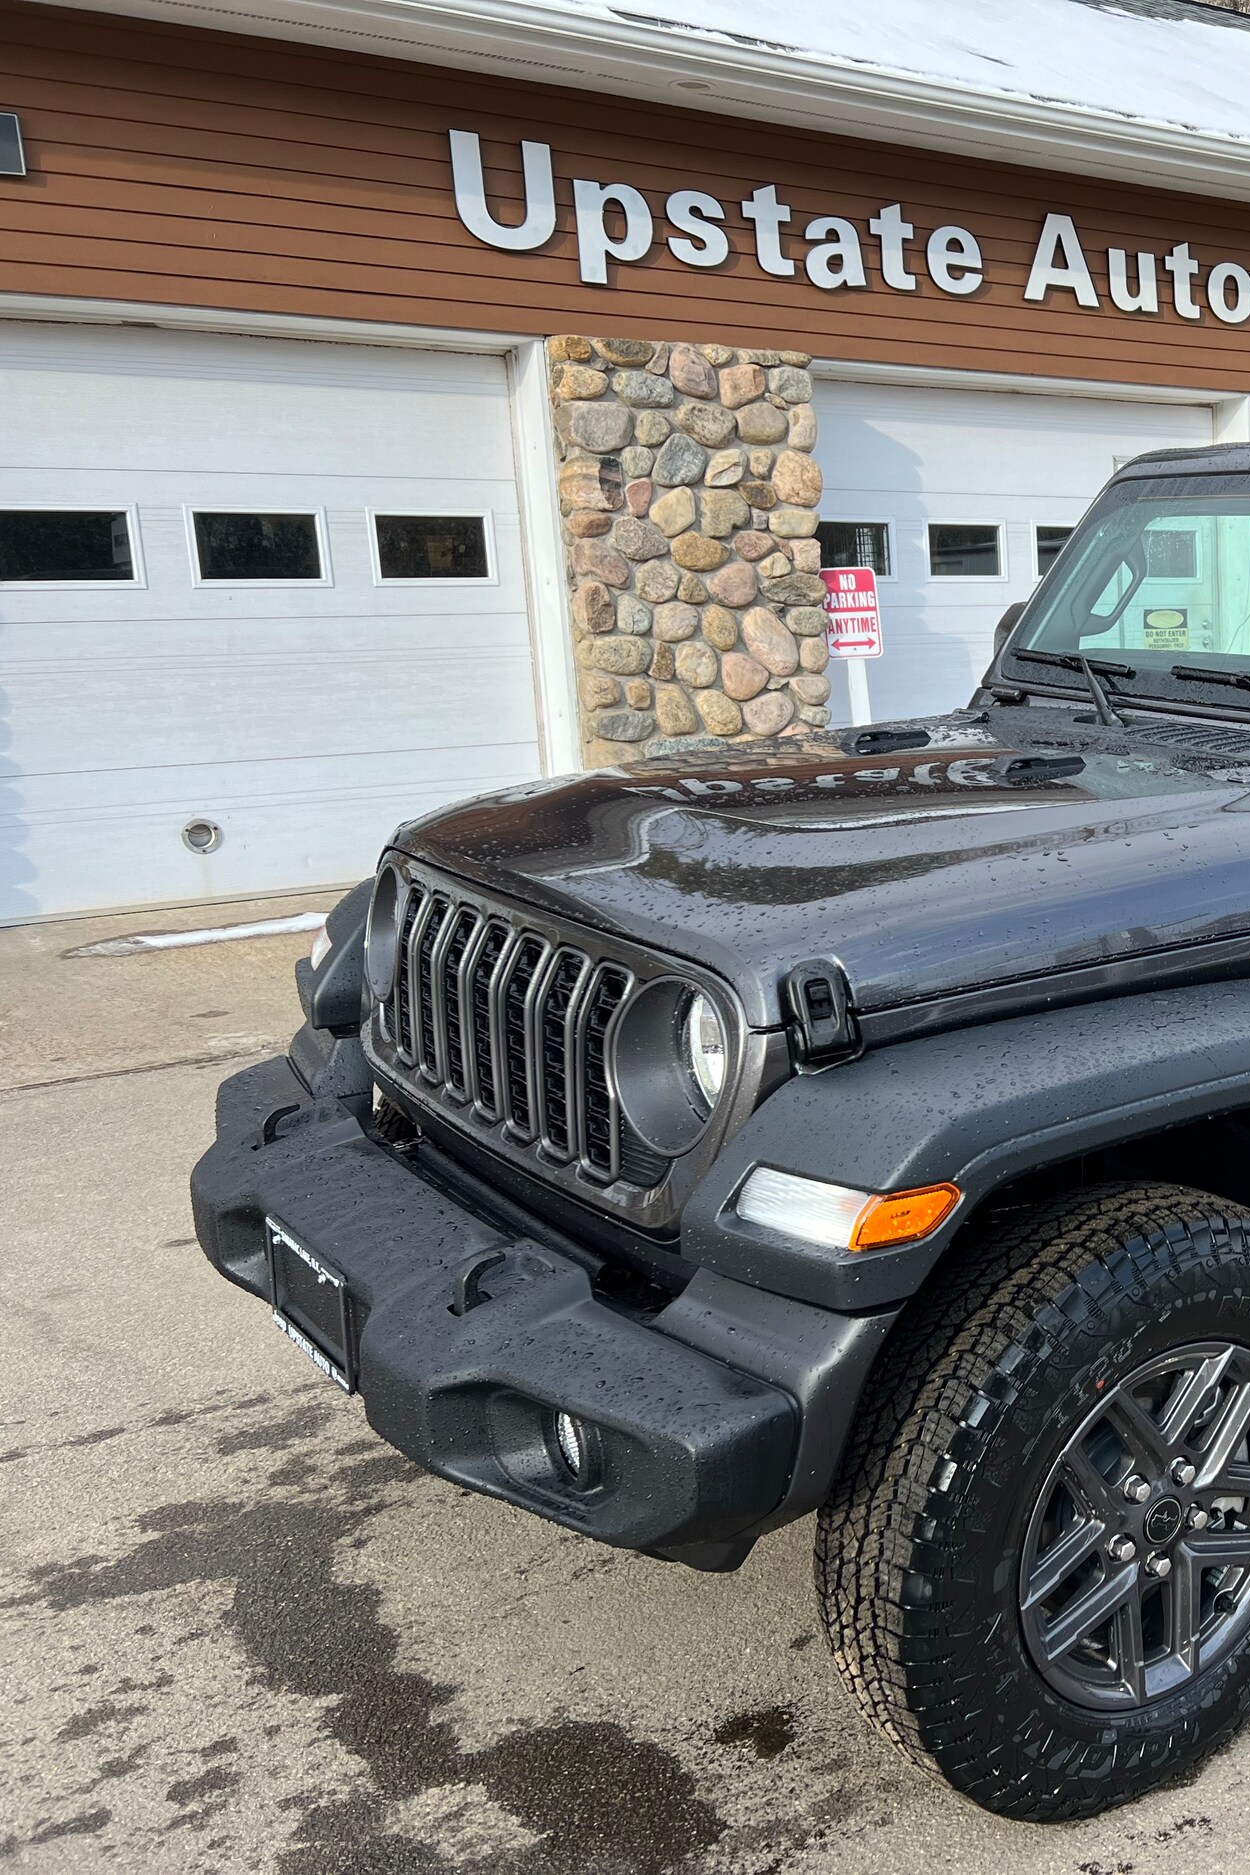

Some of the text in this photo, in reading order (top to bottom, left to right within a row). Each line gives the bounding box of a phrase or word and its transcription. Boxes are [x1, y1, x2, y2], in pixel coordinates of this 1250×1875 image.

[448, 128, 985, 294] Upstate
[838, 573, 857, 591] NO
[823, 591, 876, 609] PARKING
[827, 616, 877, 635] ANYTIME
[1145, 630, 1154, 638] DO
[1155, 630, 1167, 638] NOT
